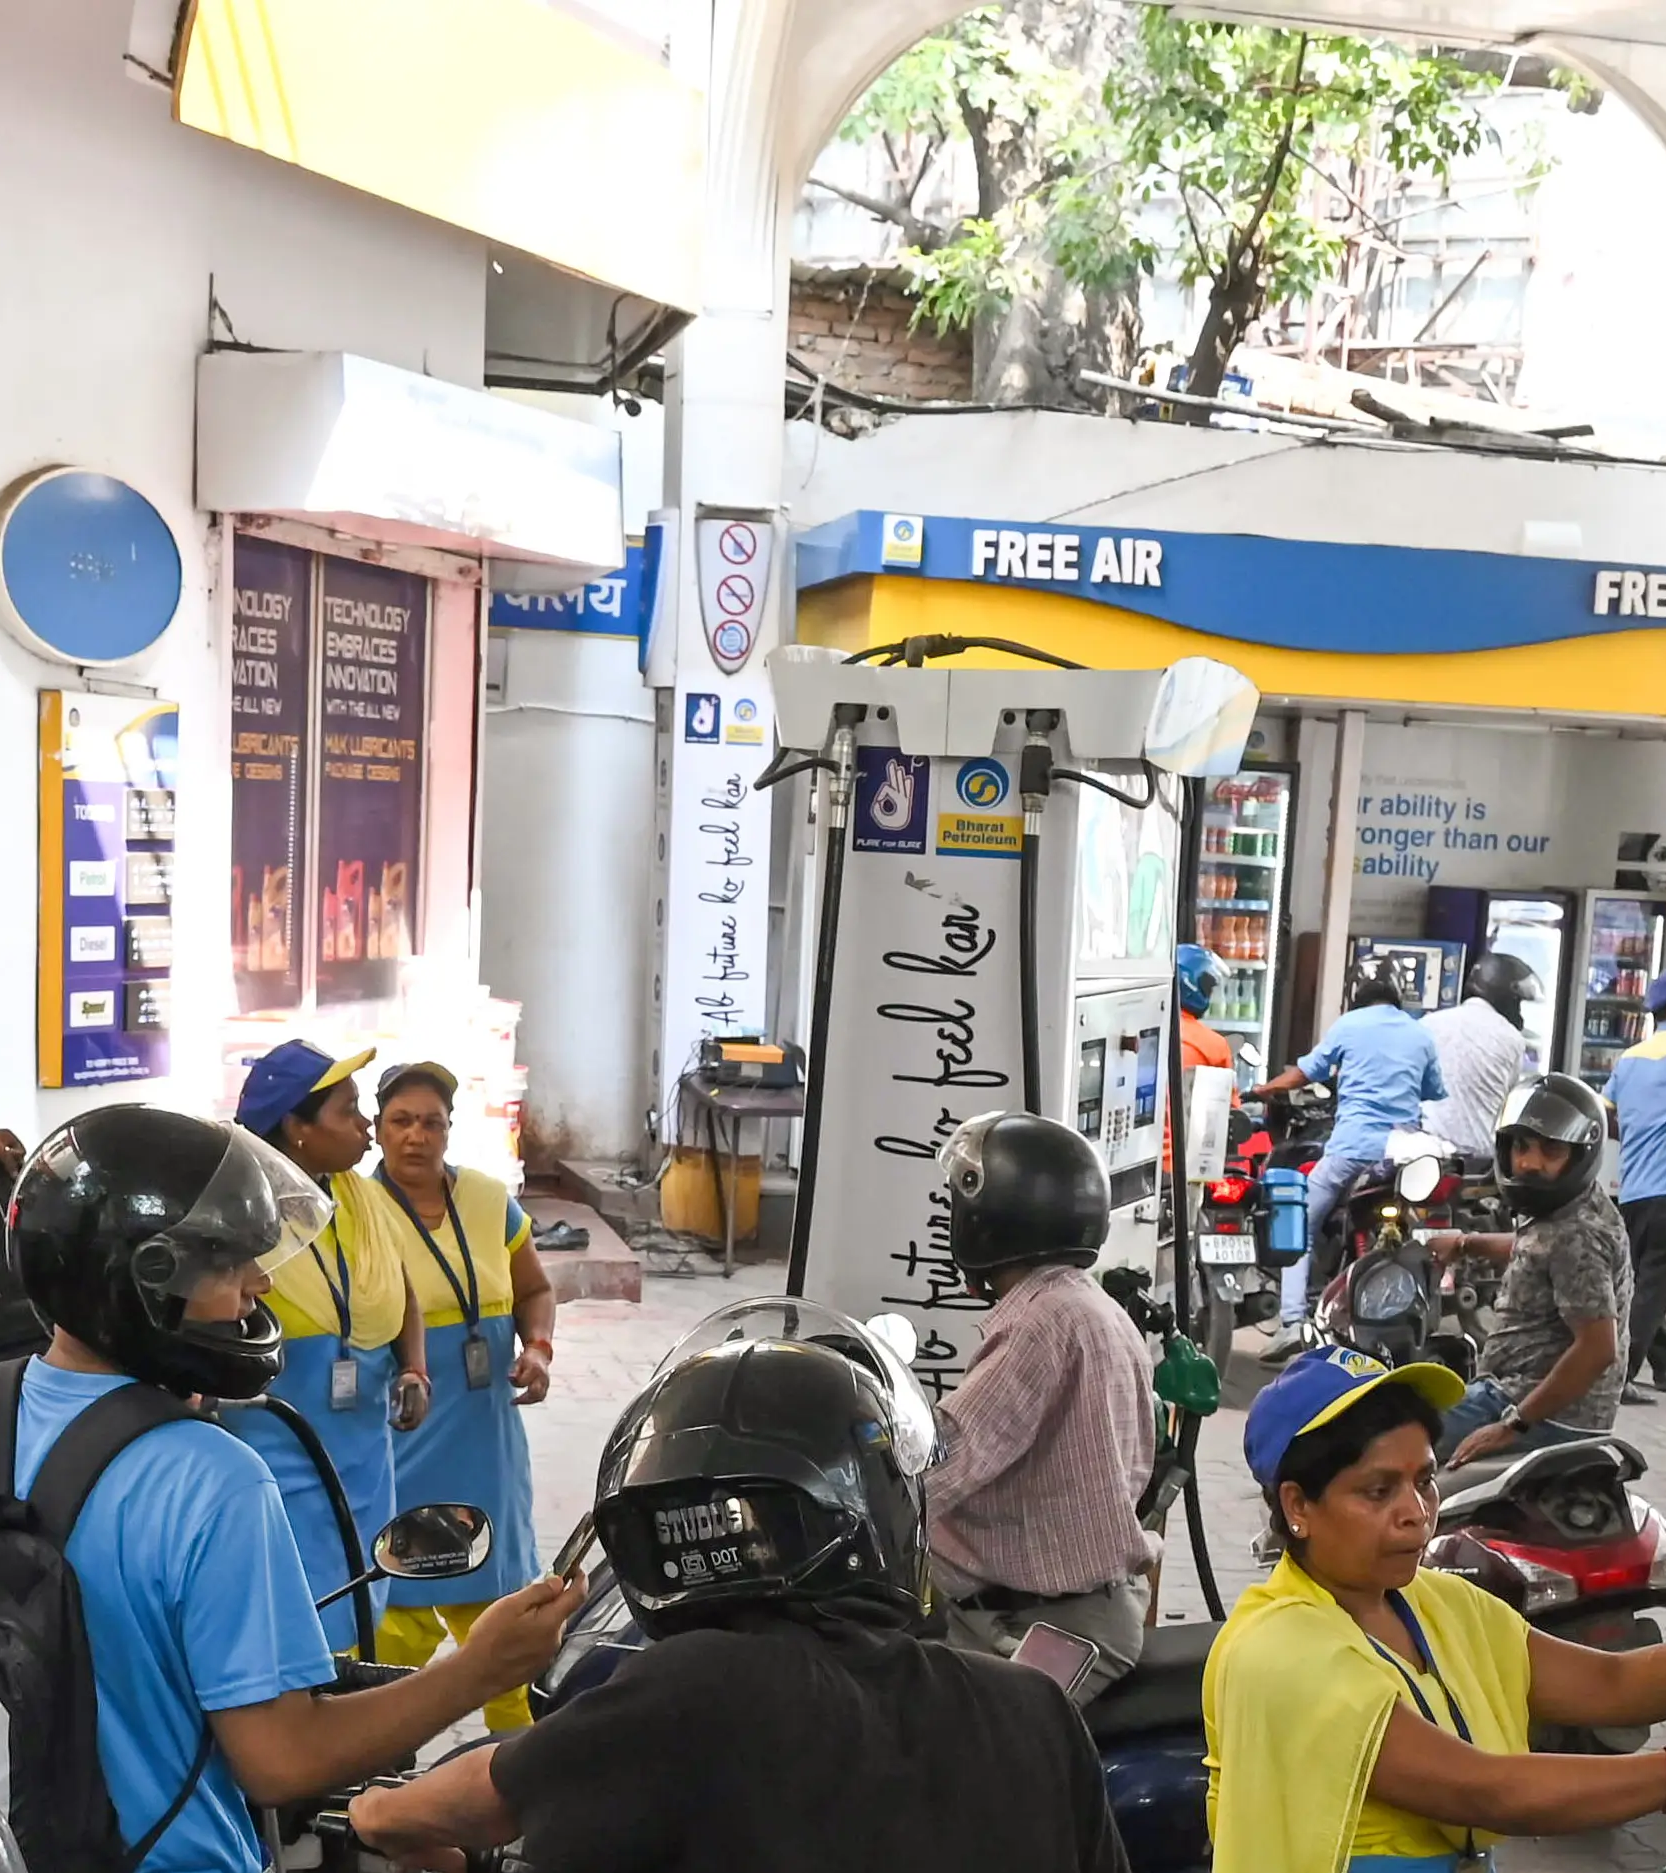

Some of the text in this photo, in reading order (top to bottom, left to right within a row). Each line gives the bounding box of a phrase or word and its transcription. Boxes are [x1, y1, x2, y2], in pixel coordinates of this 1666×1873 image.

[971, 529, 1162, 587] FREE AIR
[233, 587, 292, 622] NOLOGY
[324, 596, 411, 633] TECHNOLOGY
[232, 625, 277, 655] RACES
[326, 632, 397, 664] EMBRACES
[232, 658, 278, 689] VATION
[326, 663, 397, 696] INNOVATION
[1380, 794, 1457, 823] ability
[1465, 798, 1486, 820] is
[942, 831, 1017, 846] Petroleum
[956, 819, 1004, 832] Bharat
[1356, 826, 1550, 853] onger than our
[700, 821, 752, 866] feel
[80, 872, 107, 885] Petrol
[1353, 854, 1439, 884] sability
[699, 880, 744, 904] ko
[80, 937, 108, 951] Diesel
[877, 999, 1010, 1087] feel
[710, 1547, 739, 1566] DOT
